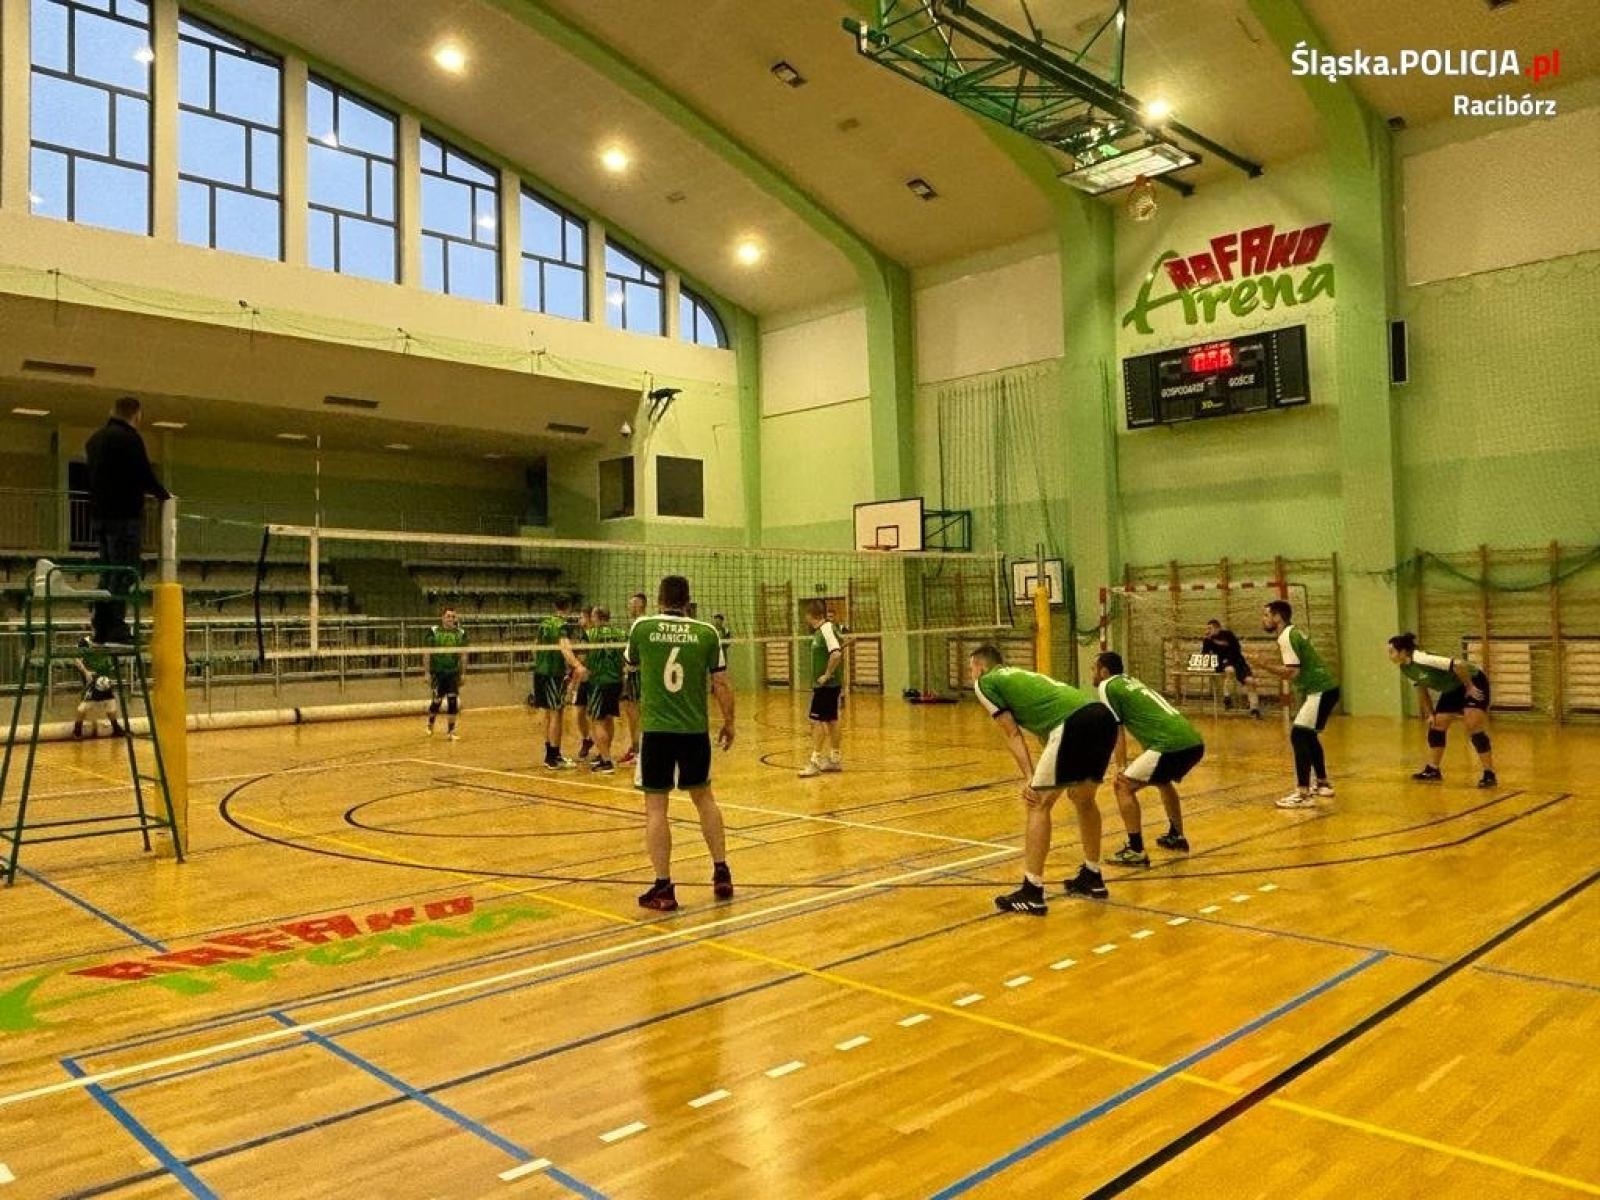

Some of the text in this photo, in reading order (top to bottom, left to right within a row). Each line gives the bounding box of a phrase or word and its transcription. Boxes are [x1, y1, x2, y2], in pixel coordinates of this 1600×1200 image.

[1121, 250, 1335, 334] Arena
[649, 631, 699, 643] GRANICZNA
[663, 646, 684, 693] 6
